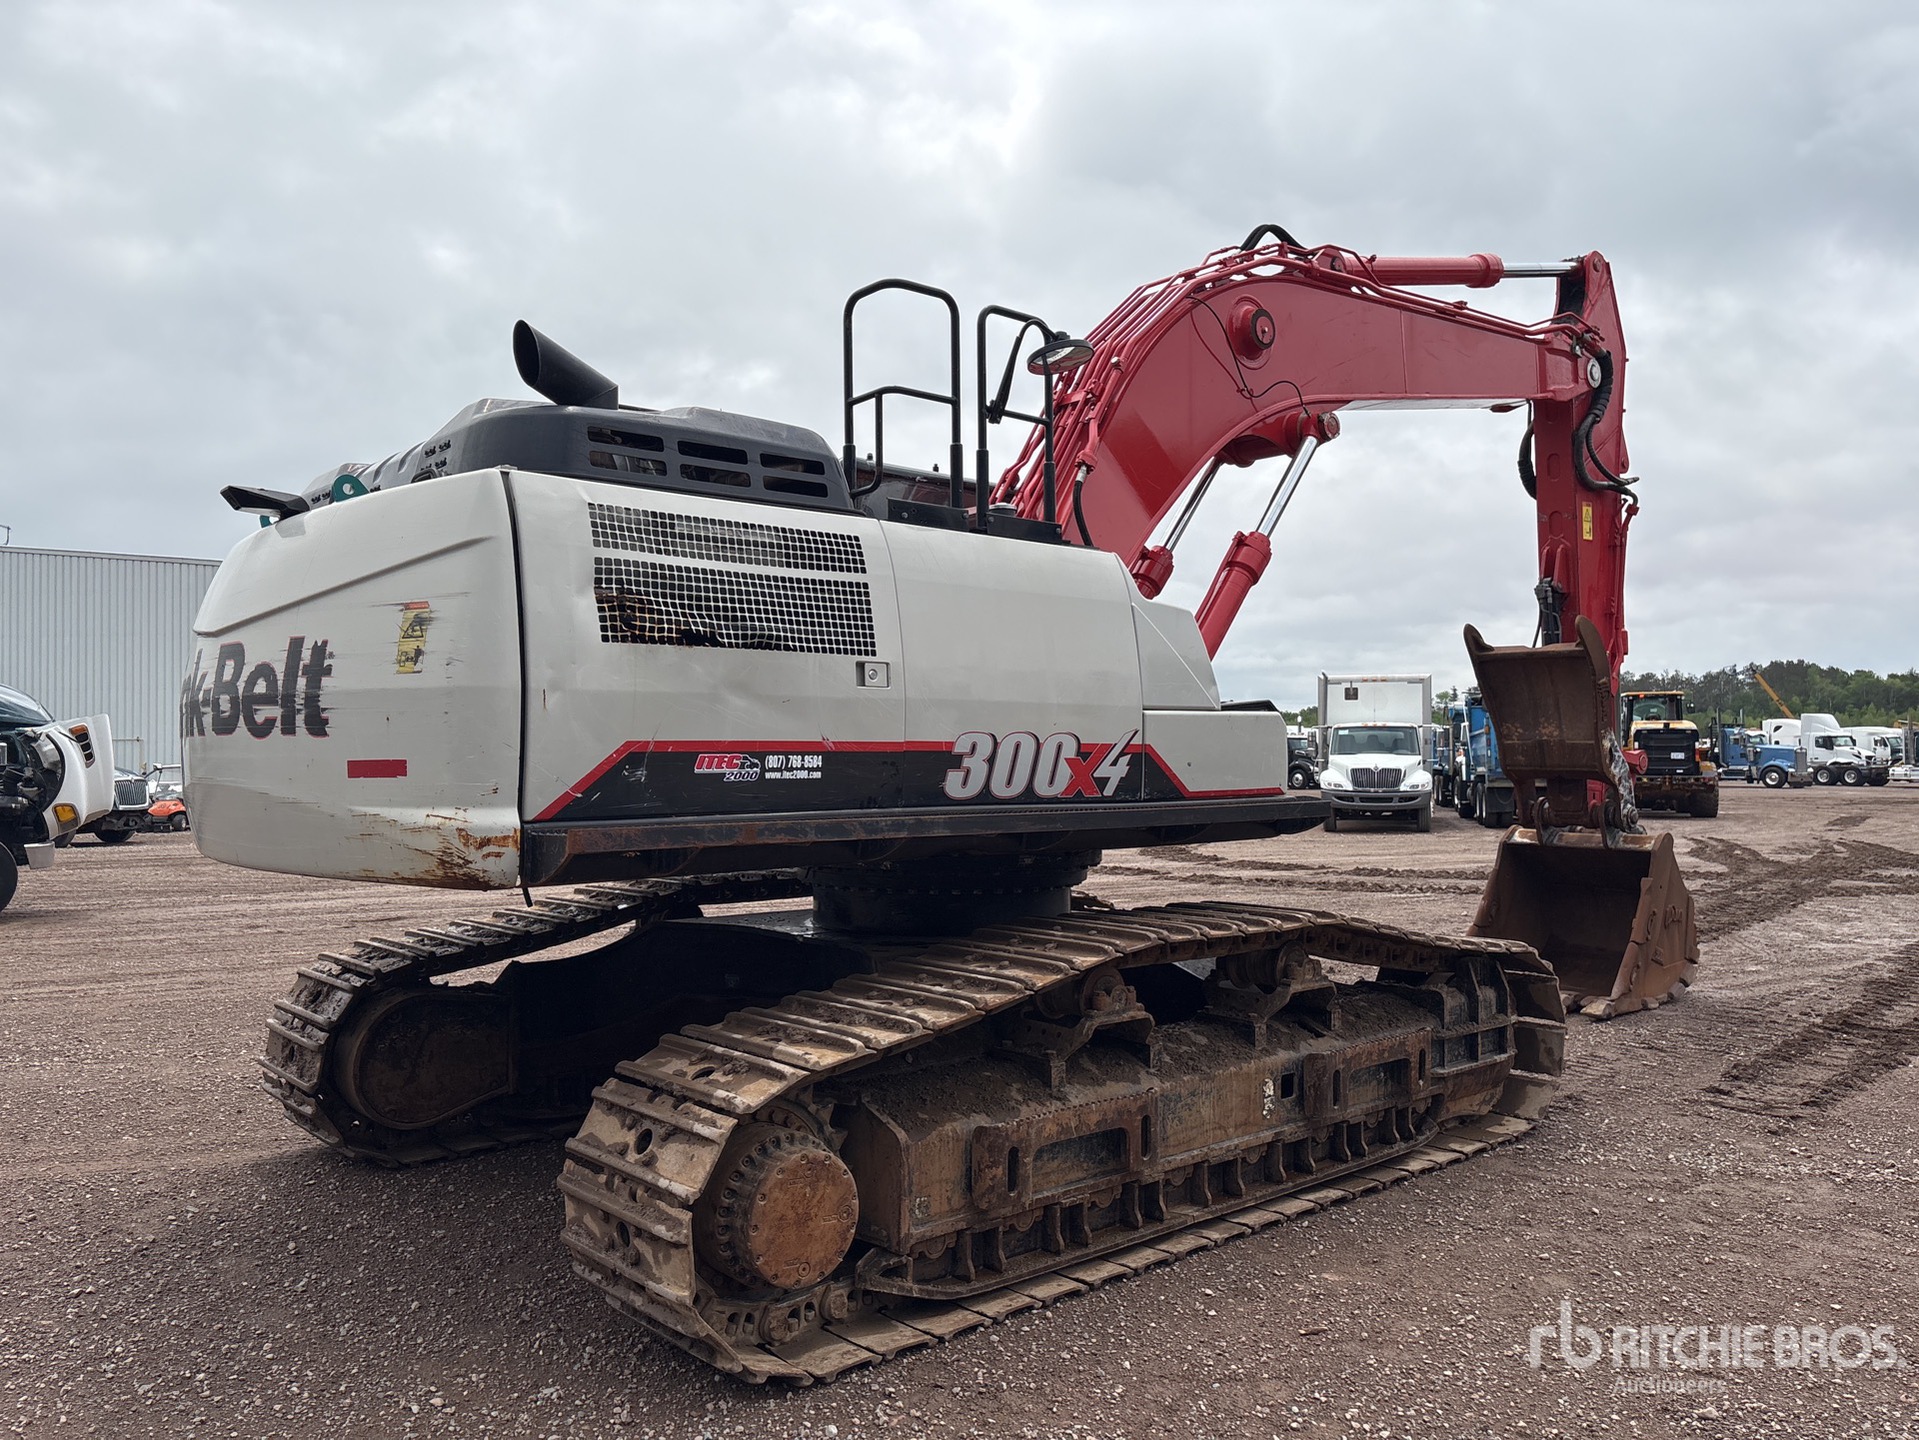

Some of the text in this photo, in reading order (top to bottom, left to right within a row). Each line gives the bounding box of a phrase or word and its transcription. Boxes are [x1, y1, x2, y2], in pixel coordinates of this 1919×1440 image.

[695, 754, 742, 771] ITEC
[765, 755, 786, 769] (807)
[724, 771, 760, 782] 2000
